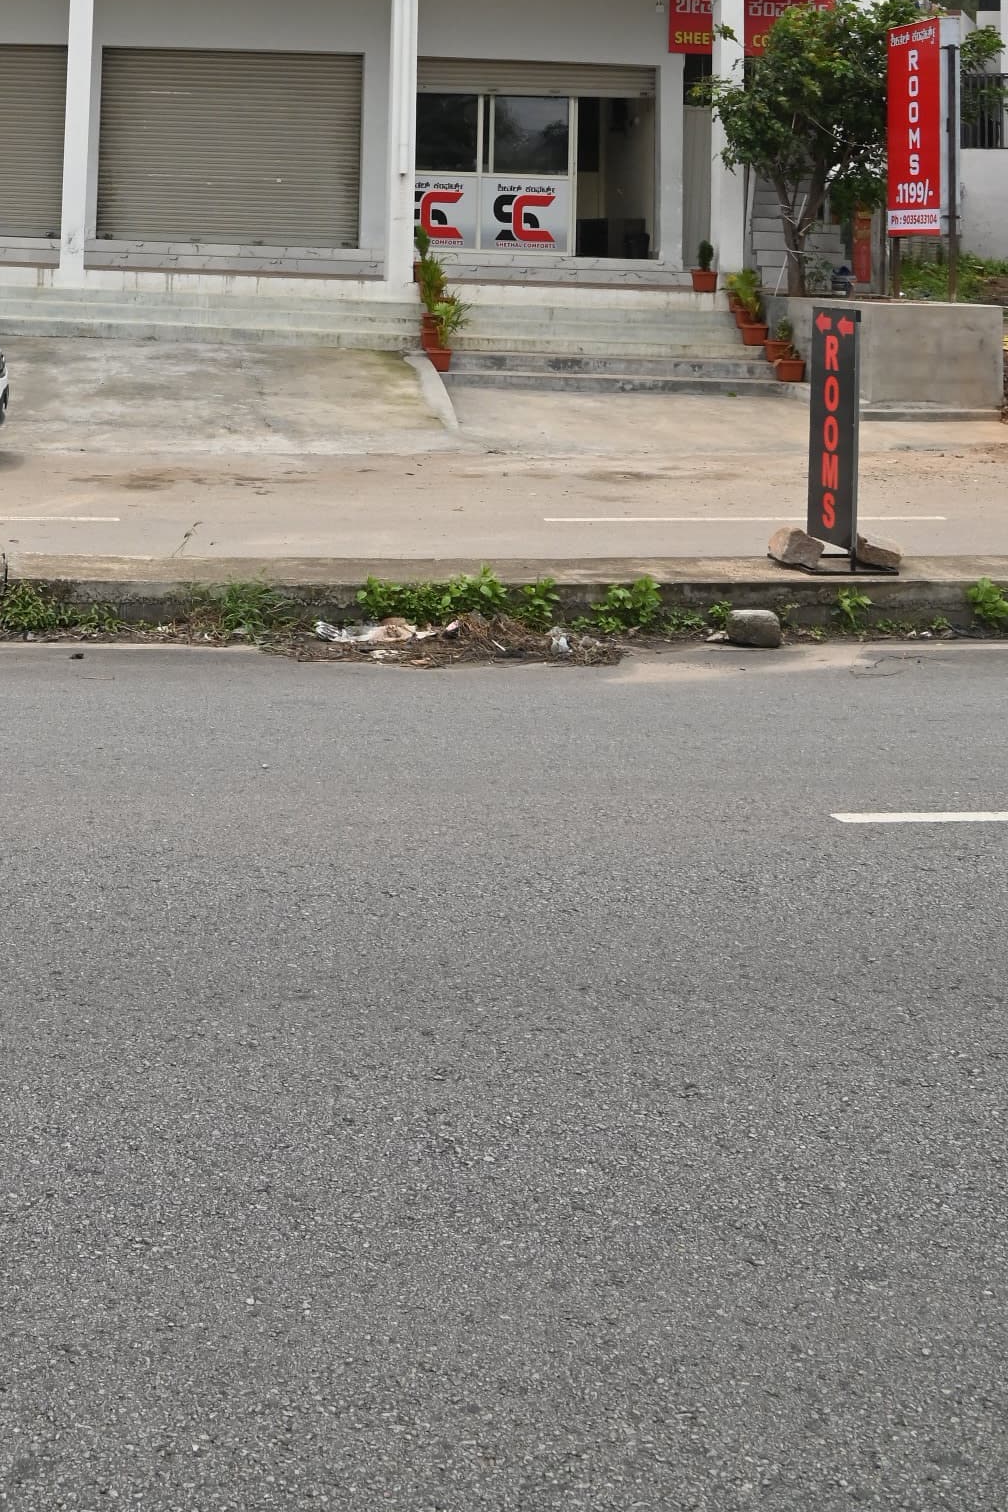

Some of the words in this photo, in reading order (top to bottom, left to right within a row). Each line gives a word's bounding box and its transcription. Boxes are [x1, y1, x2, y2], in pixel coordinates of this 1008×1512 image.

[908, 49, 921, 176] ROOMS
[890, 216, 899, 225] Ph
[902, 214, 938, 225] 9035433104
[821, 335, 840, 529] ROOMS
